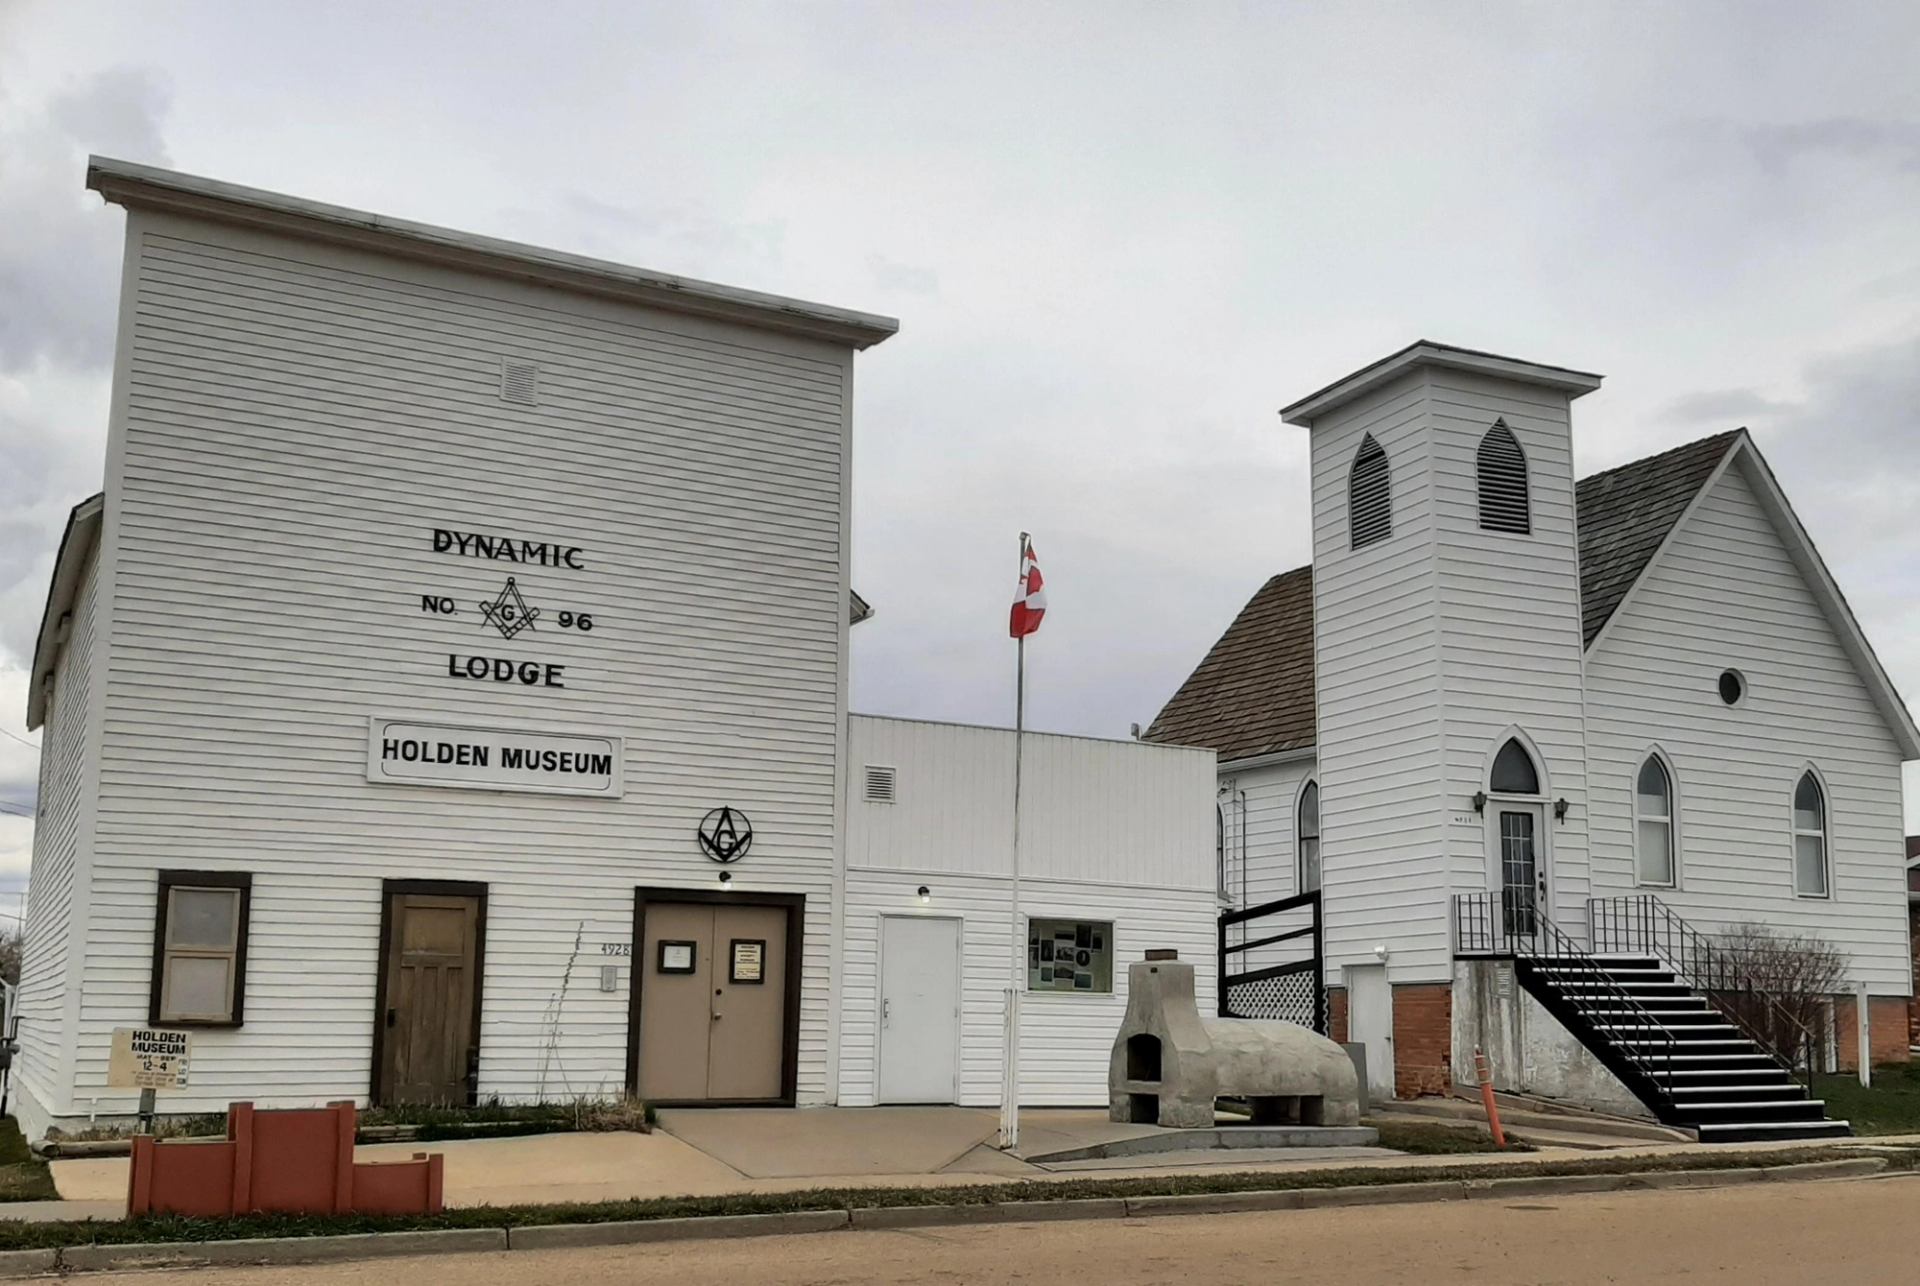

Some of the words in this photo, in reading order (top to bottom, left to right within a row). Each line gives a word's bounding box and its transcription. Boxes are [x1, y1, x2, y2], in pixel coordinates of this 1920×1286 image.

[433, 528, 584, 570] DYNAMIC
[501, 605, 515, 621] G
[558, 611, 593, 631] 96
[449, 654, 565, 688] LODGE
[382, 738, 489, 767] HOLDEN
[501, 748, 612, 775] MUSEUM
[717, 830, 734, 851] G
[601, 943, 630, 956] 4928
[132, 1031, 186, 1043] HOLDEN
[131, 1042, 185, 1054] MUSEUM
